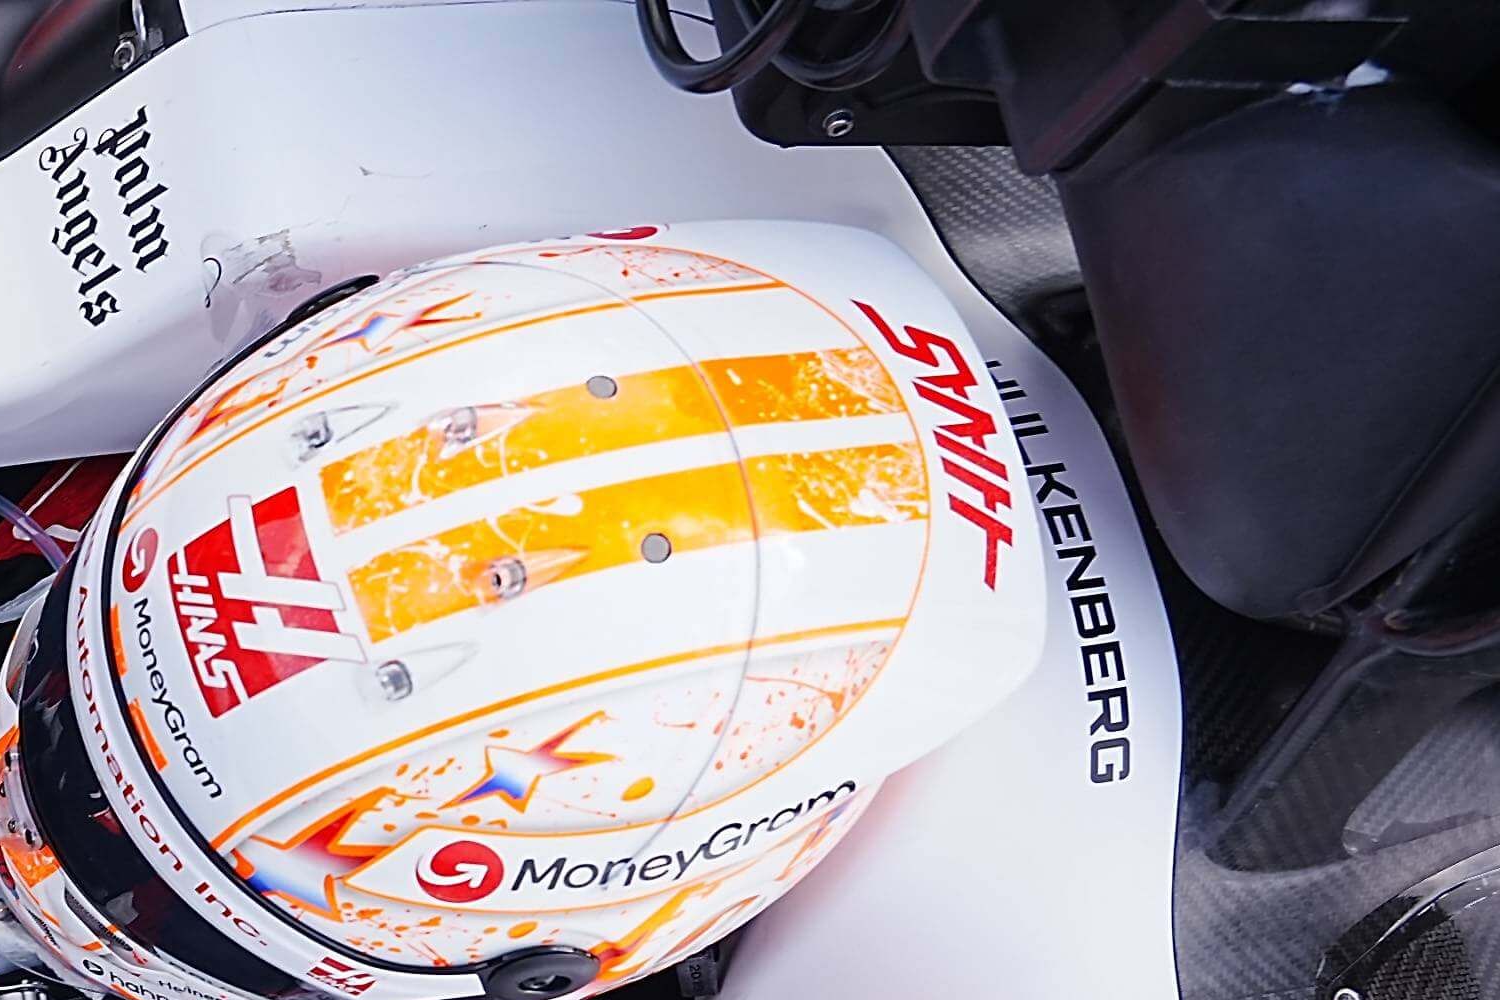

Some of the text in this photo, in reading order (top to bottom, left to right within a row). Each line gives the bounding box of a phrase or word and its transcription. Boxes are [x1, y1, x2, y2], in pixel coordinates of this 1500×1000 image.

[38, 127, 123, 327] Angels
[93, 105, 169, 273] Palm
[851, 299, 1013, 592] HAAS
[133, 597, 224, 800] MoneyGram
[171, 549, 252, 702] HAAS
[74, 586, 185, 872] Automation
[195, 881, 268, 947] Inc.
[511, 780, 857, 892] MoneyGram
